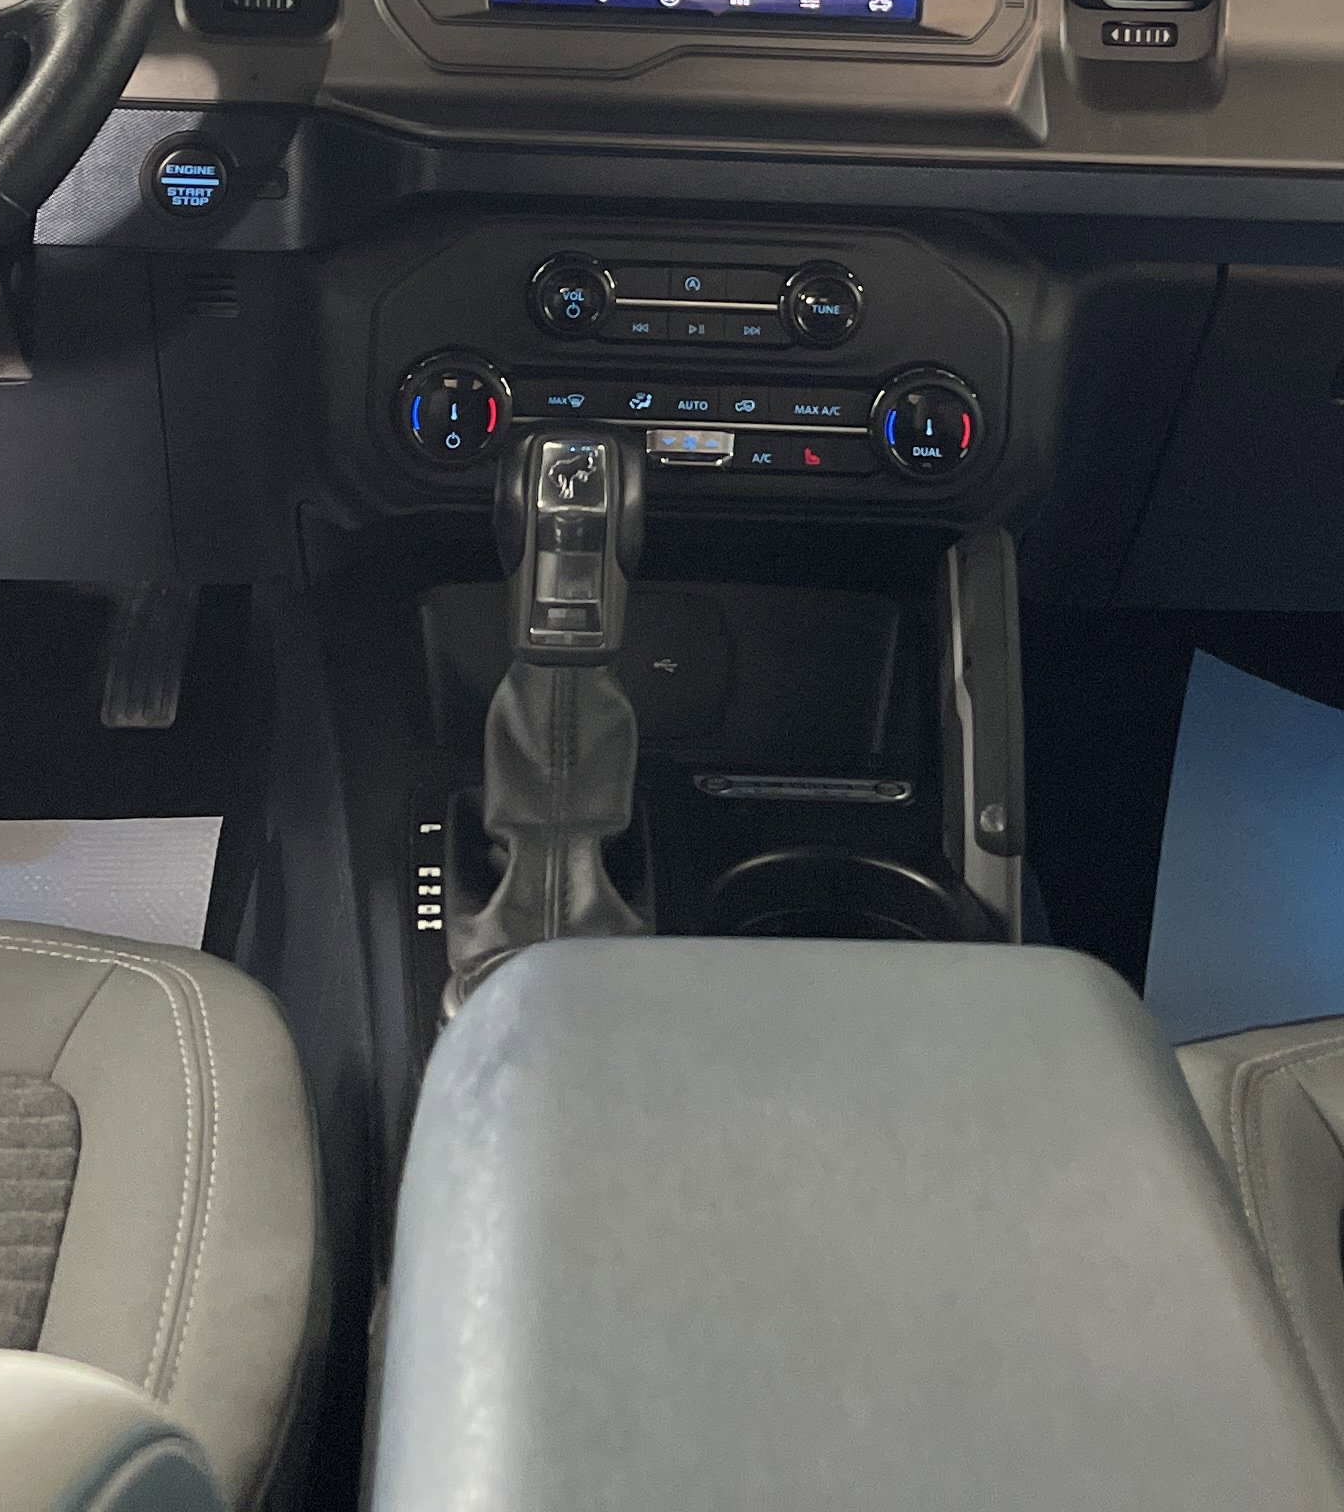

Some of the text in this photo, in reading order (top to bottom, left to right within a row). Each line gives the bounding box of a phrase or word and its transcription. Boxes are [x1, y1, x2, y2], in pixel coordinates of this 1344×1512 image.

[166, 165, 215, 175] ENGINE
[167, 187, 214, 197] START
[172, 196, 209, 206] STOP
[563, 291, 585, 302] VOL
[811, 304, 840, 315] TUNE
[548, 396, 567, 405] MAX
[677, 400, 709, 411] AUTO
[794, 404, 841, 416] MAX A/C
[751, 452, 772, 463] A/C
[912, 446, 943, 458] DUAL
